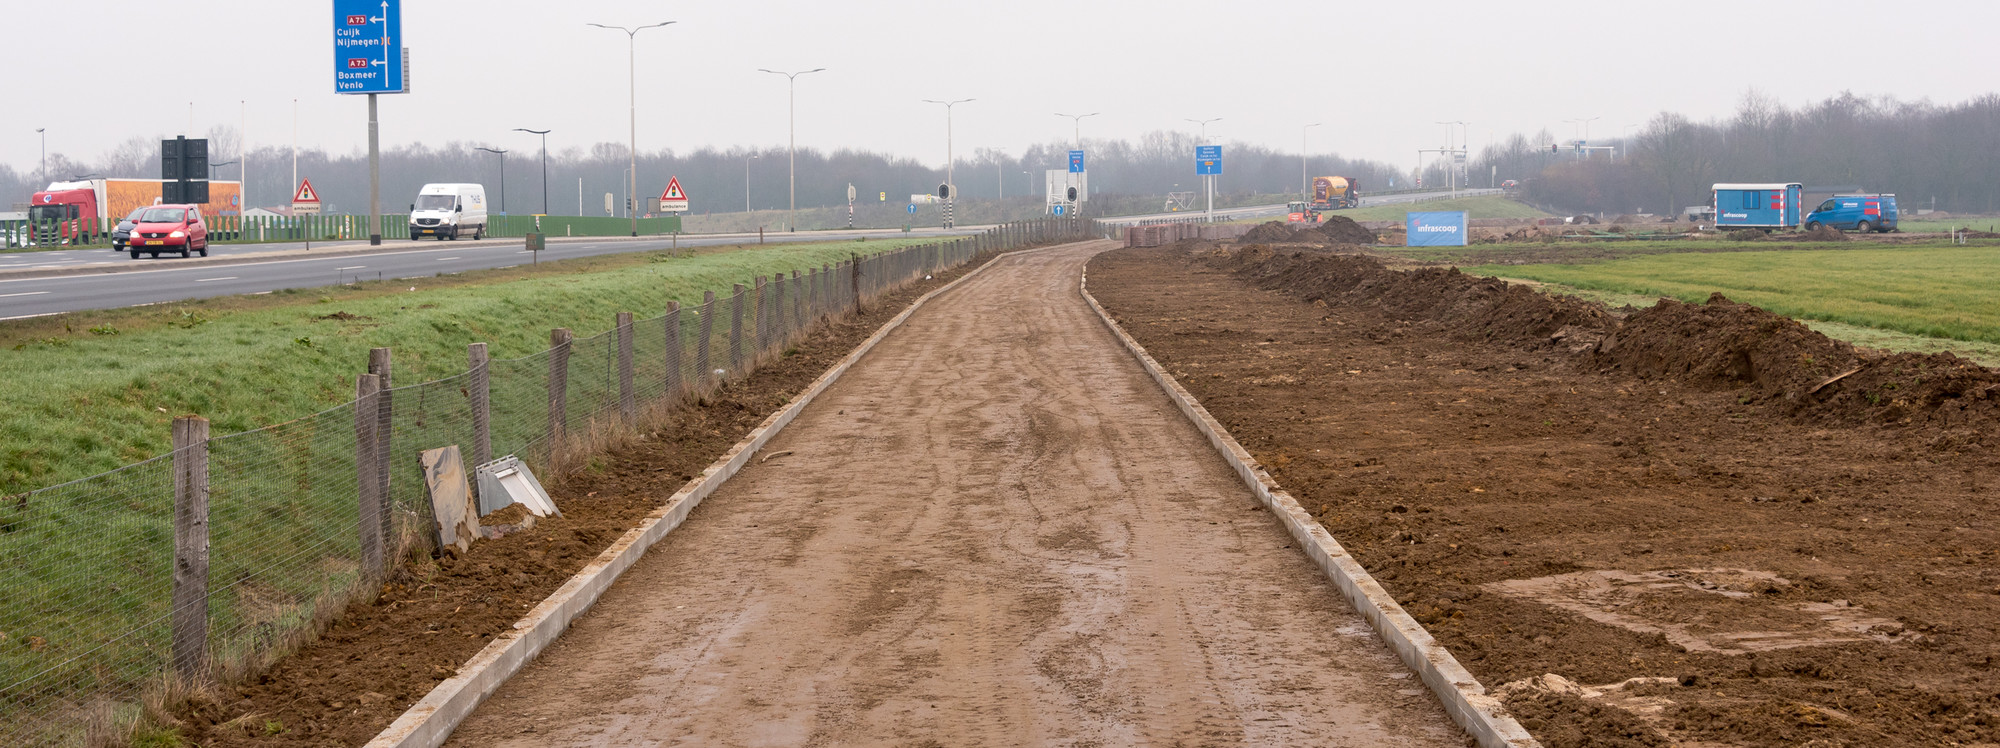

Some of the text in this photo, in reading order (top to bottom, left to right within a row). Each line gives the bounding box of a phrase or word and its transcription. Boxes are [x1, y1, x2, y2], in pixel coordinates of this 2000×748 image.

[337, 28, 360, 38] Cuijk
[337, 38, 379, 48] Nijmegen
[338, 72, 377, 80] Boxmeer
[338, 81, 364, 89] Venlo
[1418, 224, 1458, 234] infrascoop
